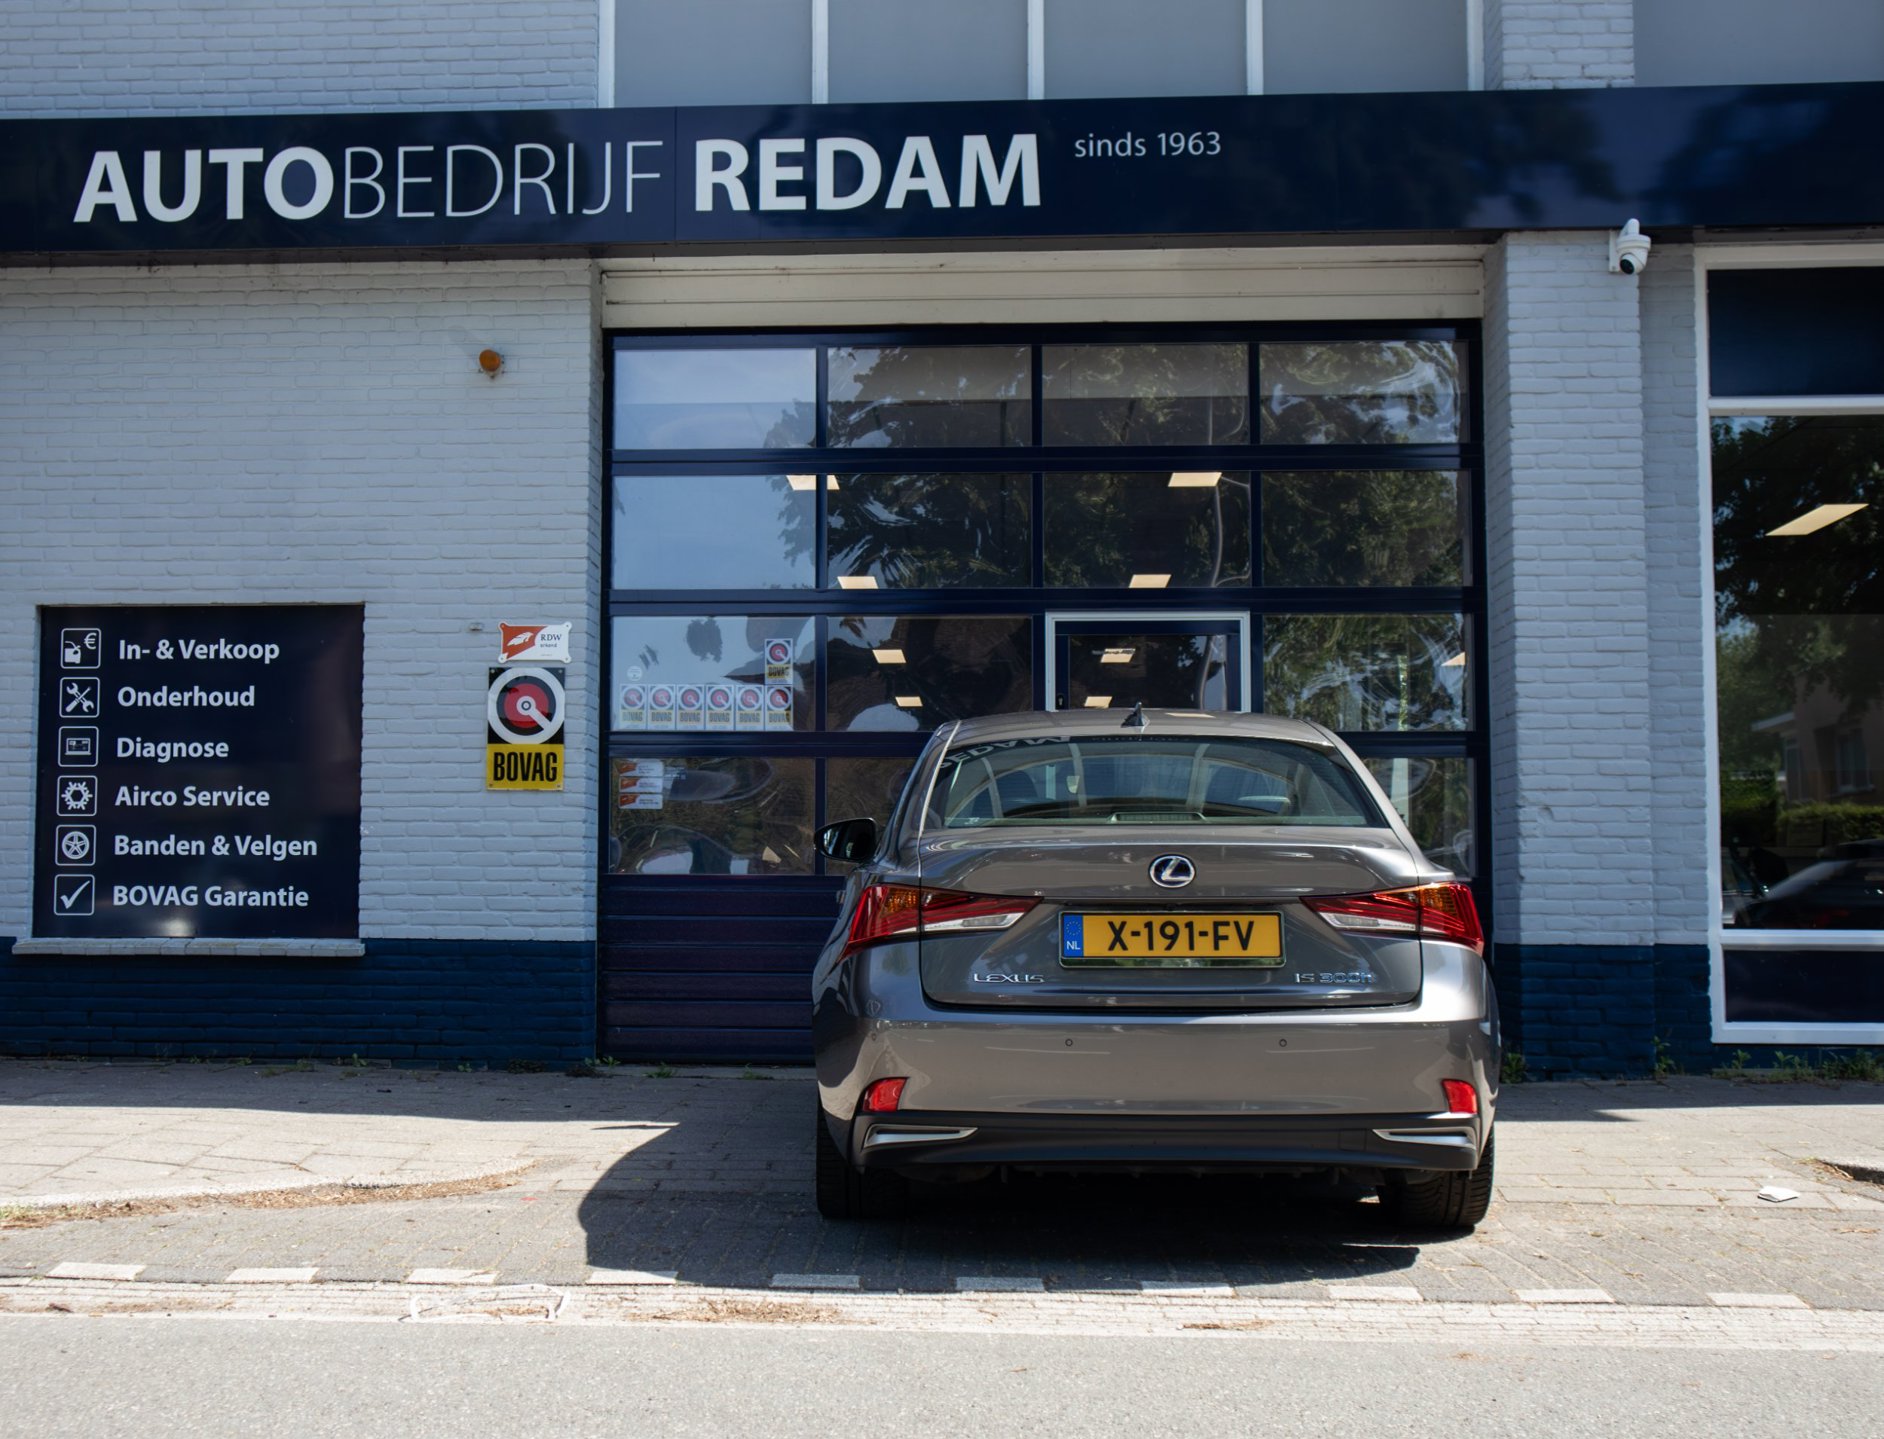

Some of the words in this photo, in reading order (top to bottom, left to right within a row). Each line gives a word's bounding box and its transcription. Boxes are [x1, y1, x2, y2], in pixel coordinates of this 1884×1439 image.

[73, 140, 664, 223] AUTOBEDRIJF
[695, 133, 1041, 212] REDAM
[1074, 132, 1147, 158] sinds
[1157, 131, 1221, 156] 1963
[540, 633, 562, 641] RDW
[119, 639, 151, 660] In-
[155, 639, 174, 660] &
[178, 638, 280, 665] Verkoop
[768, 666, 790, 677] BOVAG
[117, 685, 255, 707] Onderhoud
[651, 711, 673, 722] BOVAG
[679, 711, 701, 723] BOVAG
[709, 712, 731, 723] BOVAG
[739, 712, 761, 723] BOVAG
[116, 736, 230, 763] Diagnose
[493, 751, 558, 783] BOVAG
[114, 785, 178, 807] Airco
[183, 785, 270, 807] Service
[114, 834, 206, 856] Banden
[211, 835, 230, 856] &
[234, 834, 318, 861] Velgen
[113, 885, 199, 907] BOVAG
[204, 885, 309, 907] Garantie
[1107, 920, 1255, 952] X-191-FV
[1066, 940, 1081, 950] NL
[974, 973, 1045, 983] LEXUS
[1296, 973, 1315, 983] IS
